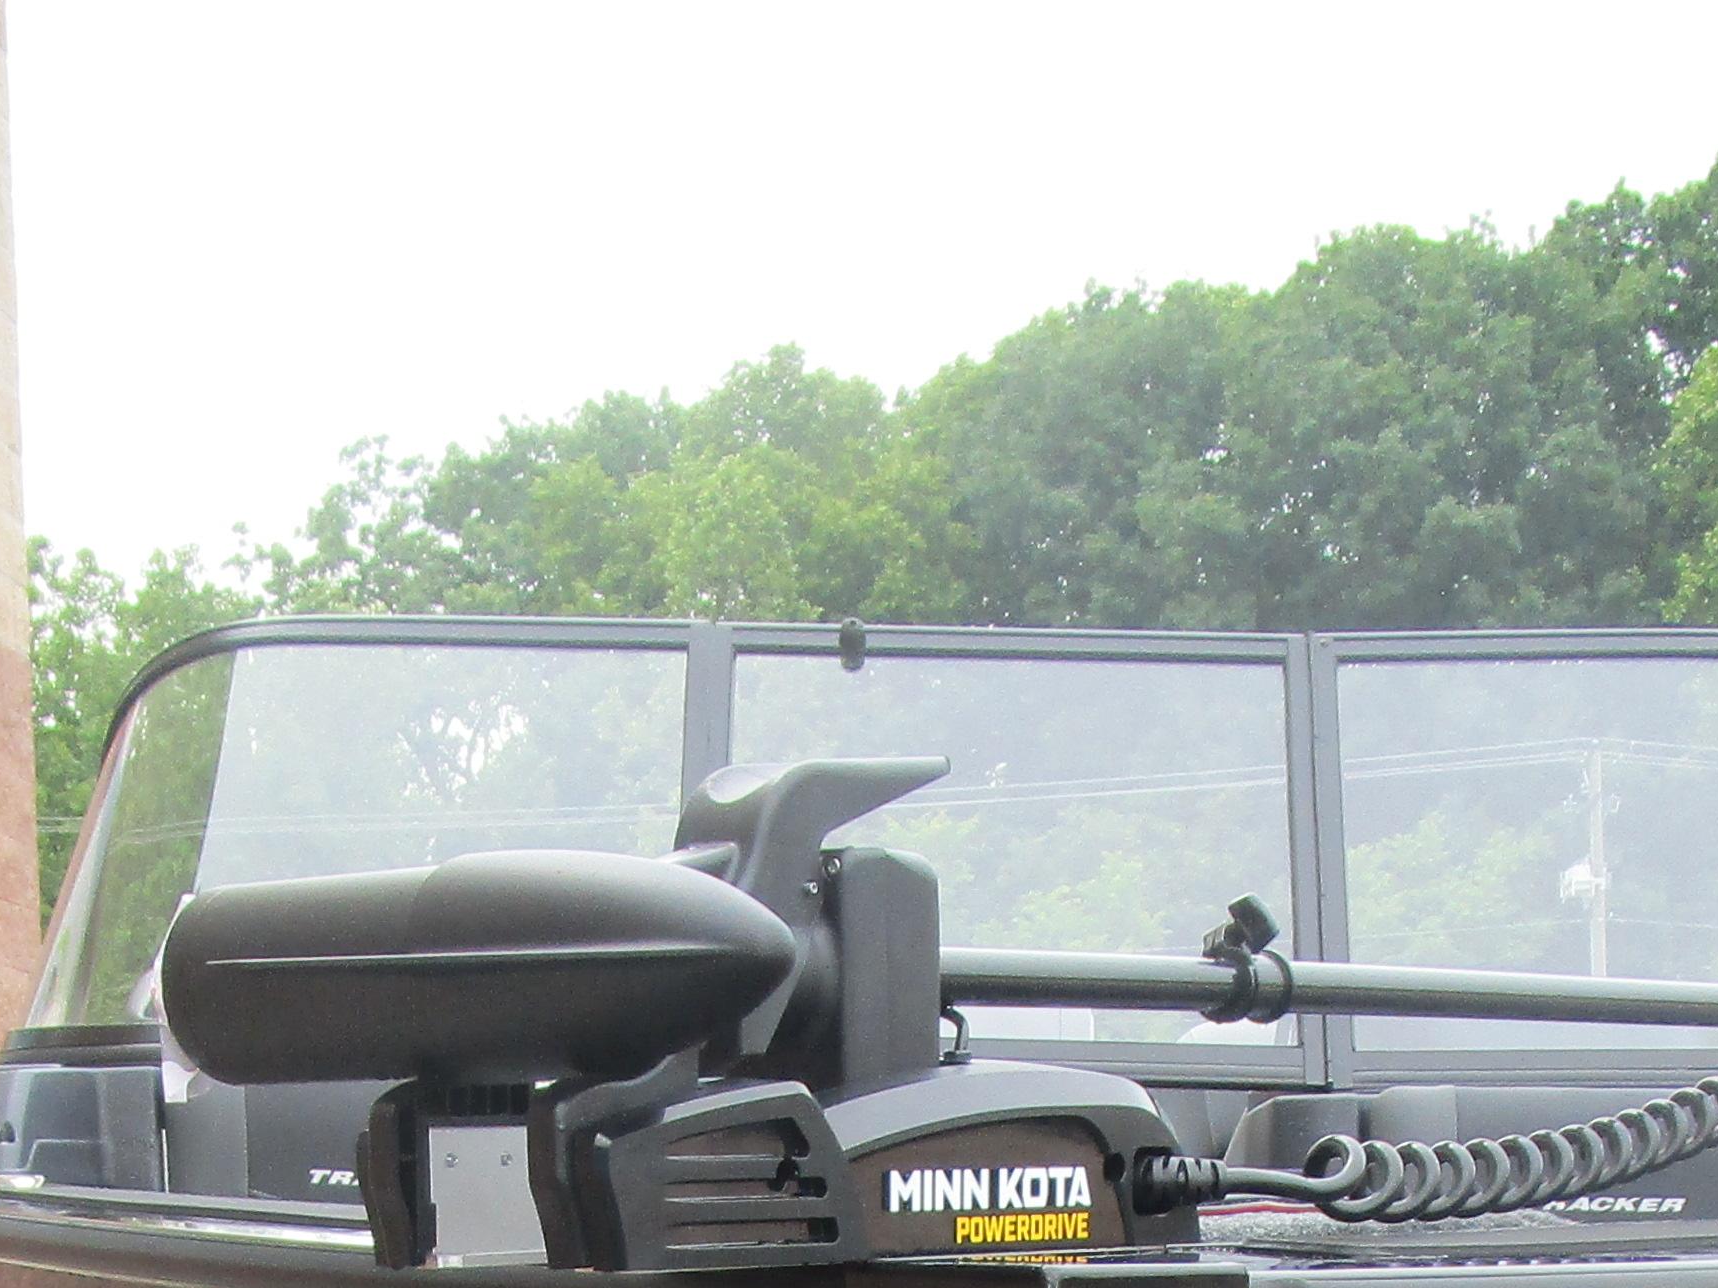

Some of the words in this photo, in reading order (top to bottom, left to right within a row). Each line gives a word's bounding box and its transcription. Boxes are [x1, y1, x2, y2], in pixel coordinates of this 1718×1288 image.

[888, 1168, 990, 1213] MINN
[996, 1166, 1093, 1209] KOTA
[955, 1211, 1090, 1245] POWERDRIVE
